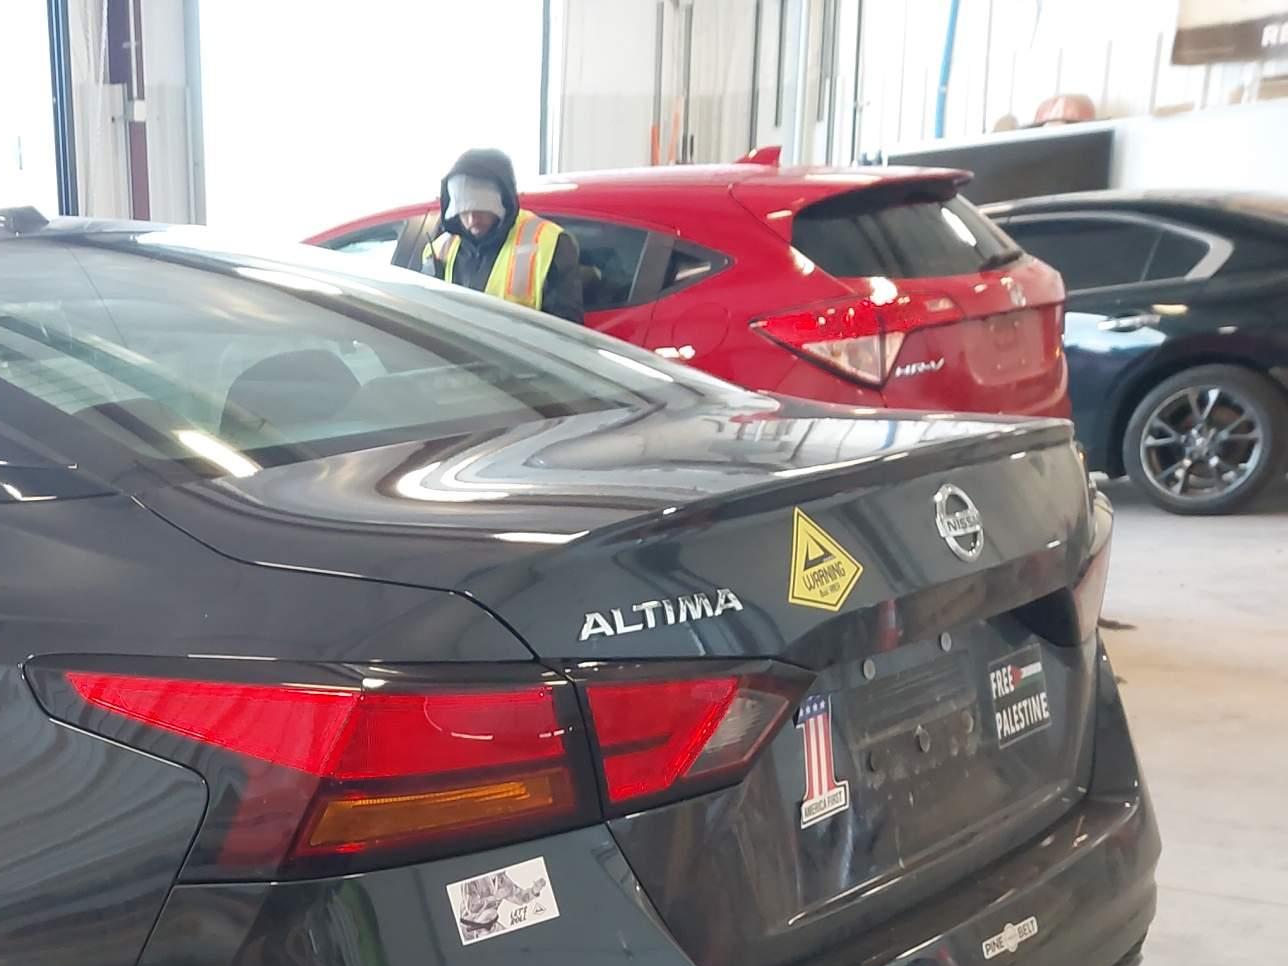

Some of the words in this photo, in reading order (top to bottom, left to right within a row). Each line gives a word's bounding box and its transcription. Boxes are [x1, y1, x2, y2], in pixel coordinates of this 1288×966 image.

[803, 561, 846, 591] WARNING
[579, 588, 744, 641] ALTIMA
[990, 664, 1015, 700] FREE
[995, 692, 1050, 740] PALESTINE
[985, 936, 1004, 957] PINE
[1017, 920, 1036, 939] BELT
